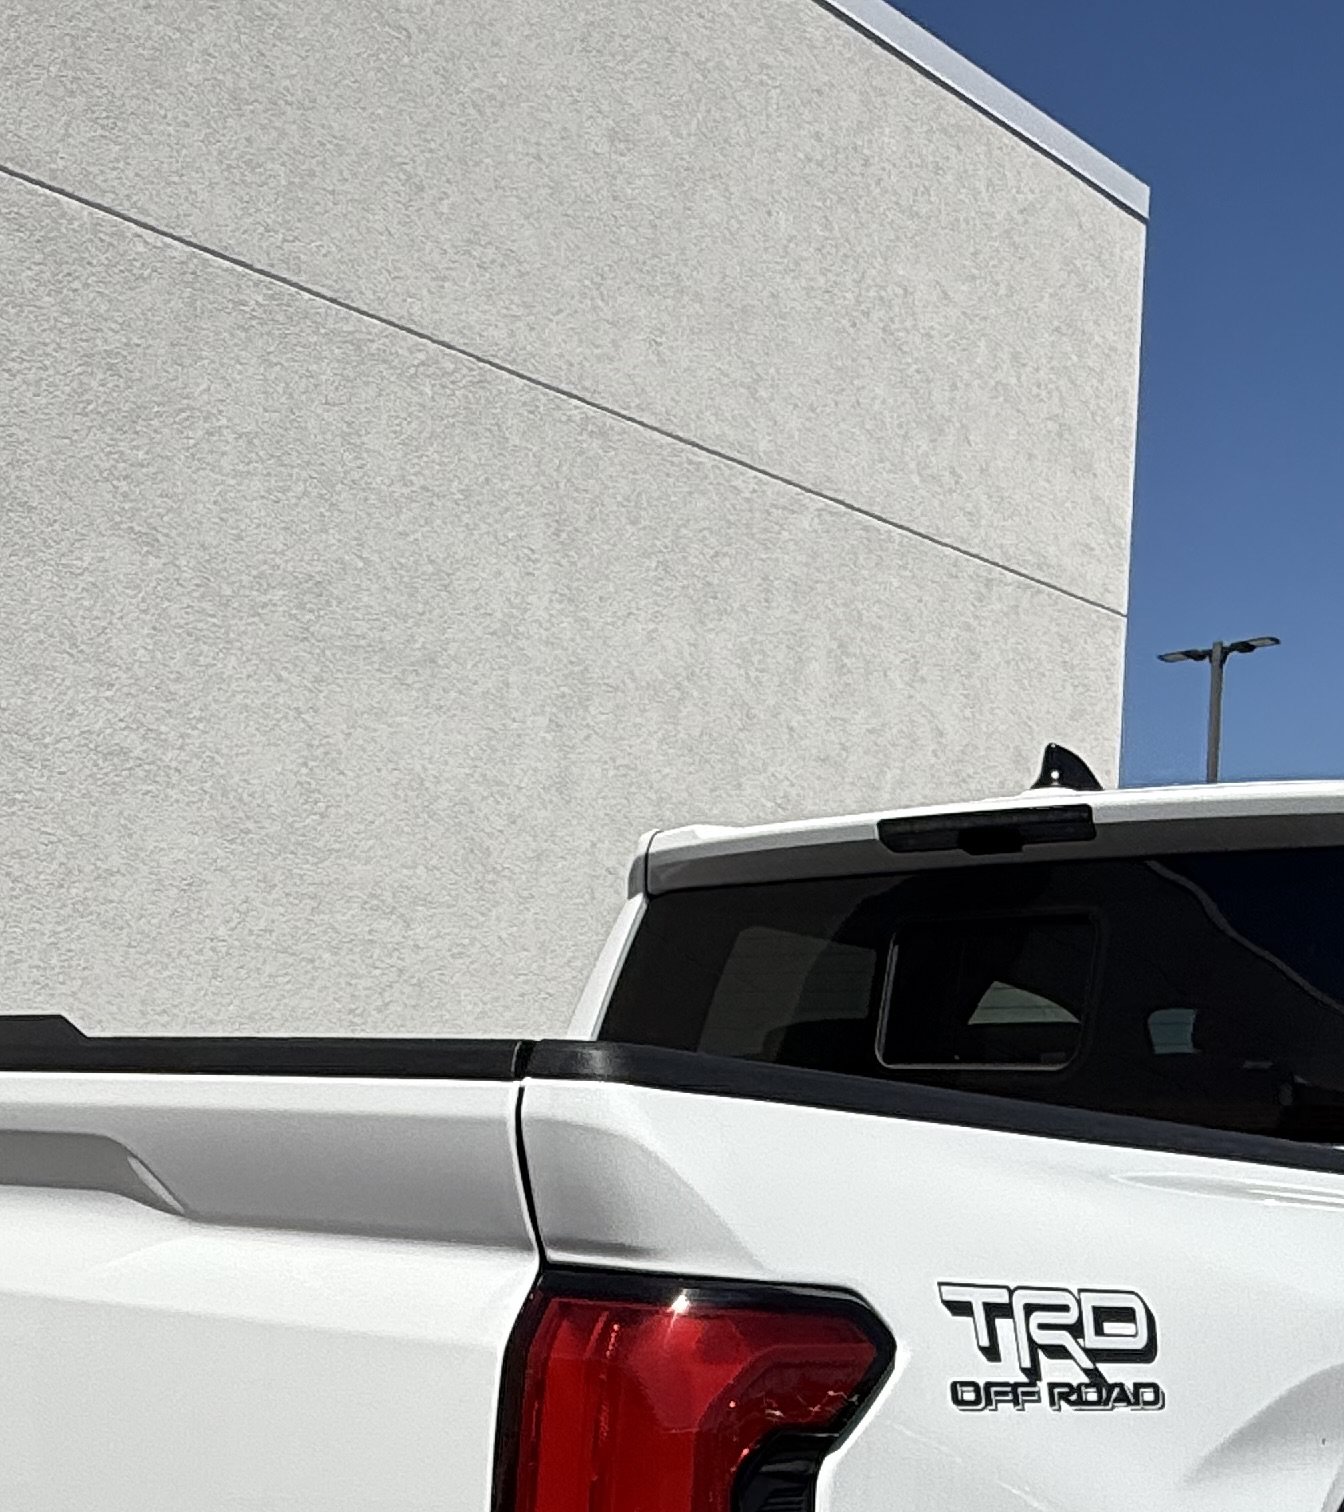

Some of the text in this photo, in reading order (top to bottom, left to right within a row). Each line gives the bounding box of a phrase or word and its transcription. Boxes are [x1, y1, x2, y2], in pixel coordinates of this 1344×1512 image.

[937, 1278, 1157, 1383] TRD
[950, 1381, 1166, 1411] OFF ROAD
